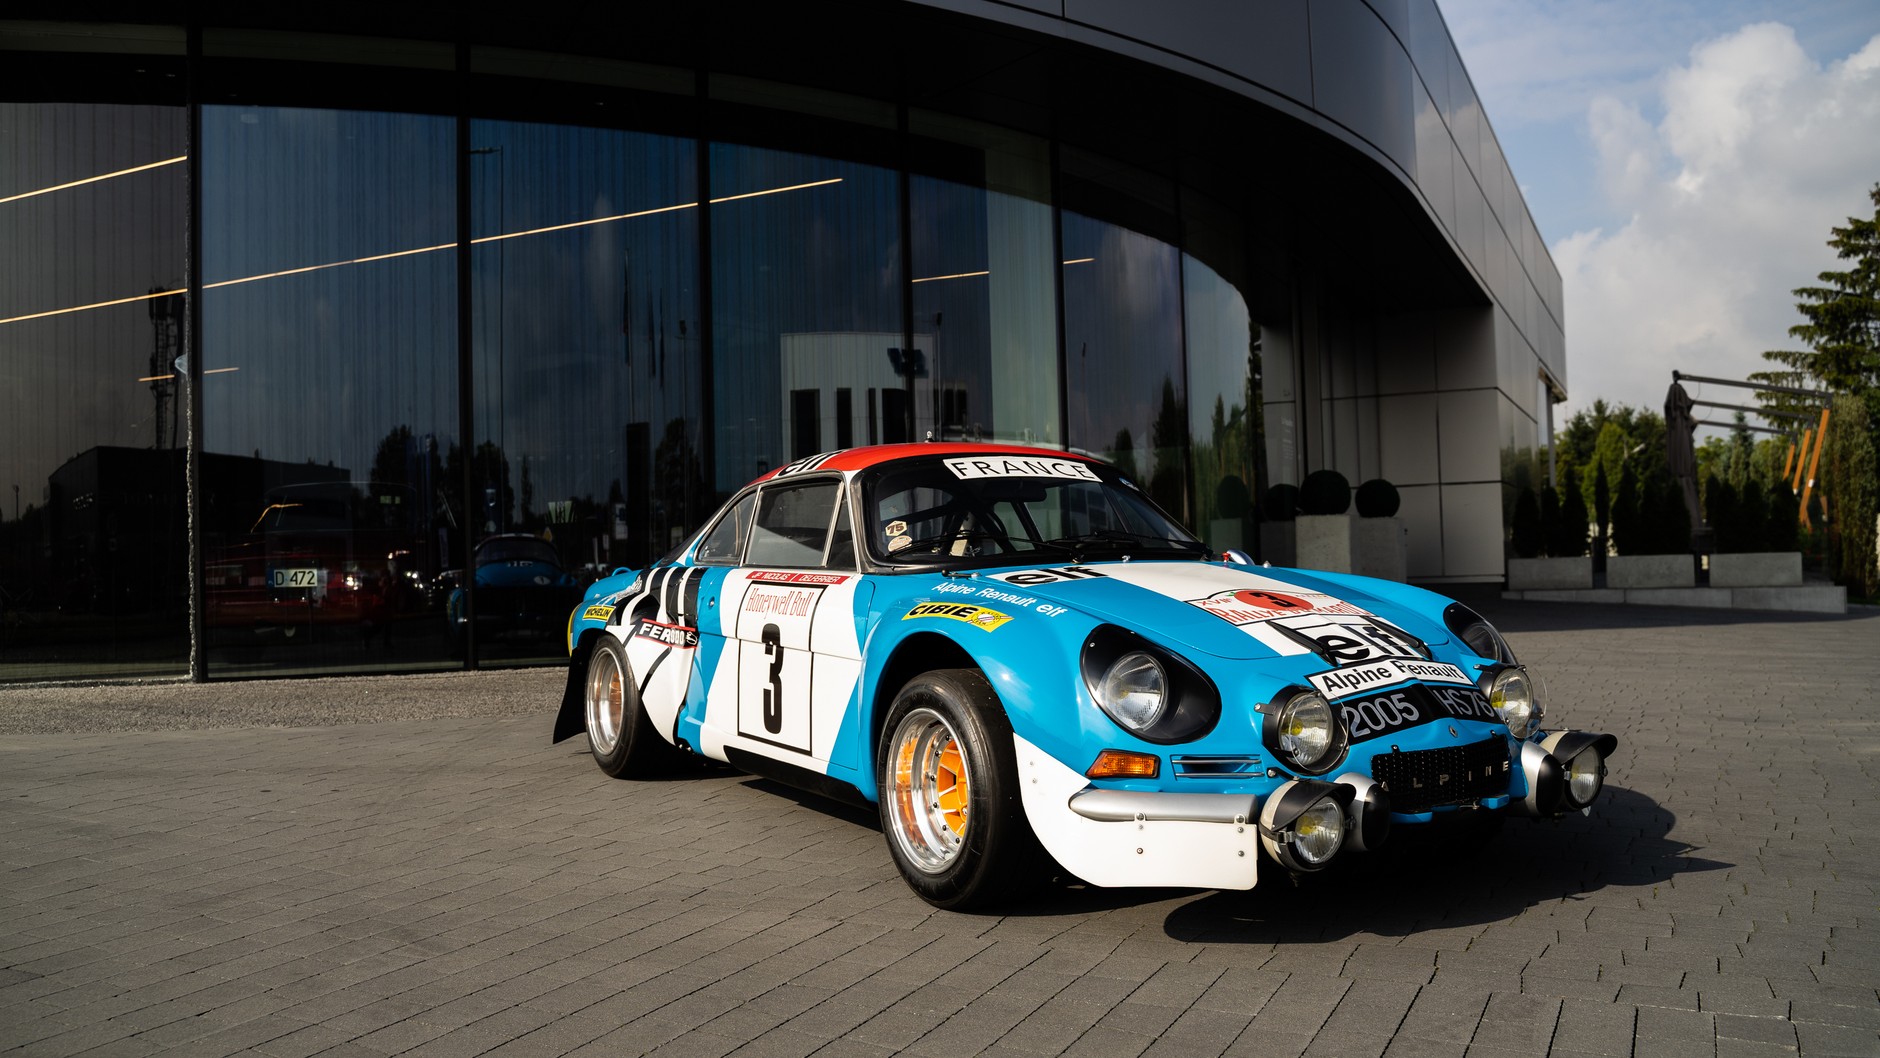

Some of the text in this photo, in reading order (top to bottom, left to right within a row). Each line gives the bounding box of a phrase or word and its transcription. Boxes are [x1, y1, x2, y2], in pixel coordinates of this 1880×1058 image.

[951, 460, 1094, 479] FRANCE
[887, 522, 904, 534] 75
[275, 570, 315, 586] D 472
[1004, 566, 1107, 584] elf
[745, 588, 815, 619] Honeywell Bull
[931, 581, 1068, 618] Alpine Renault elf
[1248, 591, 1299, 608] 3
[584, 607, 612, 617] MICHELIN
[909, 604, 979, 618] CIBIE
[1206, 607, 1286, 623] RALLYE
[1317, 625, 1410, 660] elf
[761, 623, 784, 734] 3
[1322, 660, 1463, 693] Alpine Renault
[1340, 690, 1495, 737] 2005 HS76
[1381, 761, 1508, 792] ALPINE
